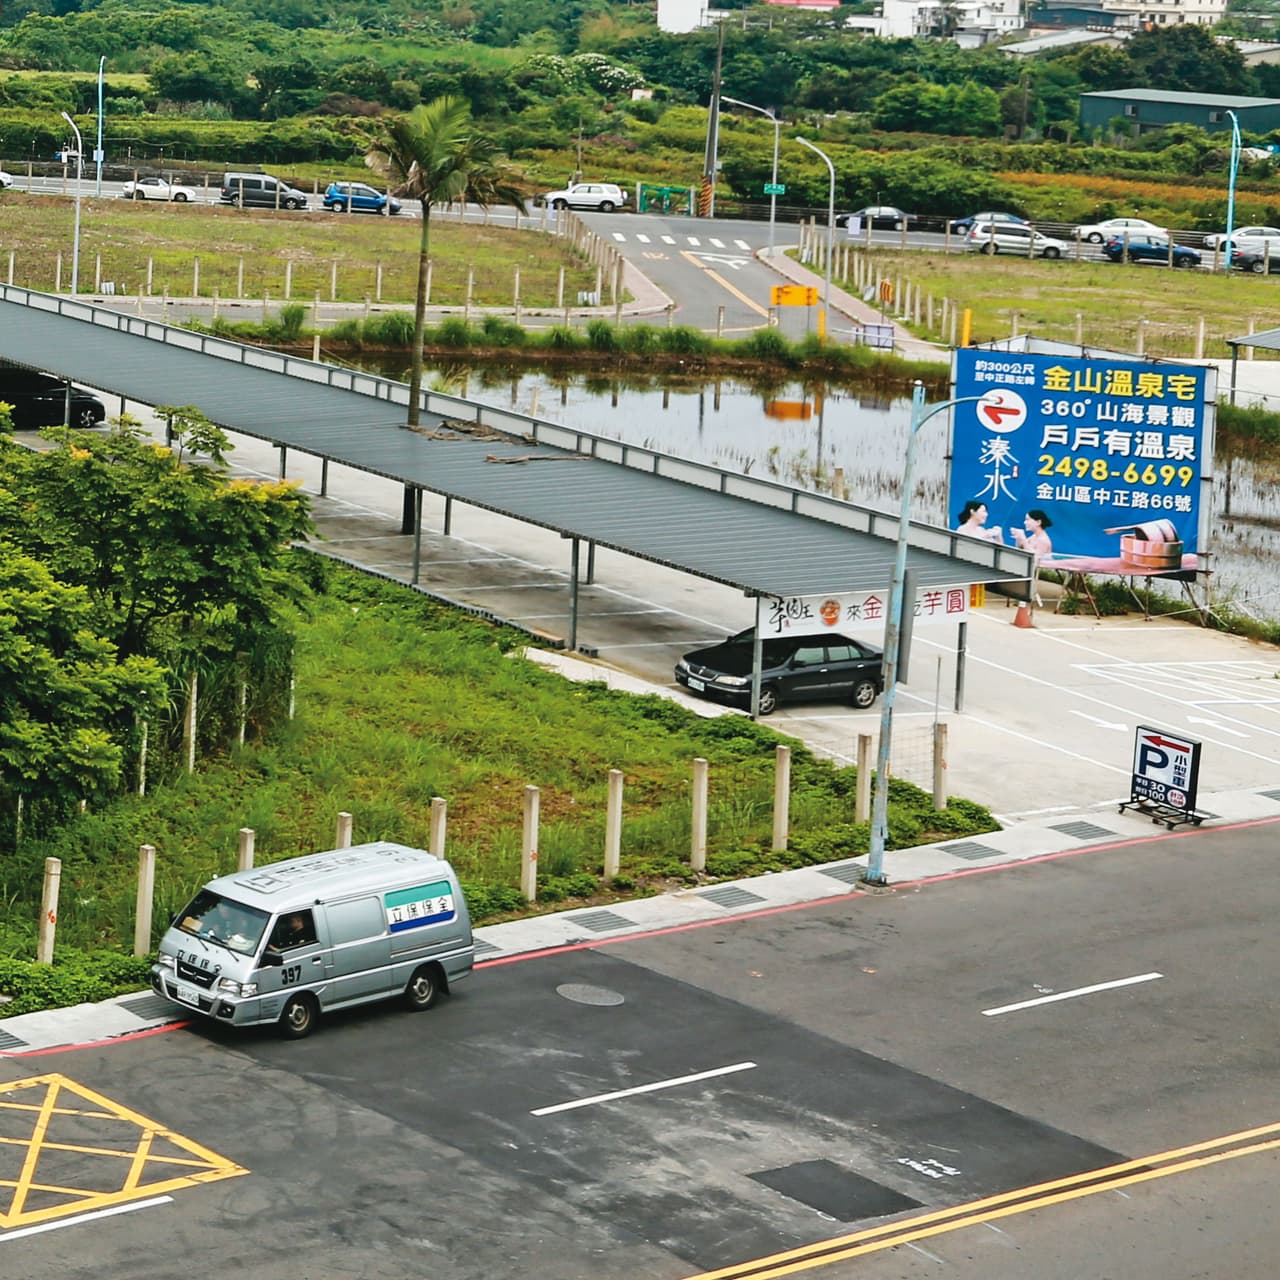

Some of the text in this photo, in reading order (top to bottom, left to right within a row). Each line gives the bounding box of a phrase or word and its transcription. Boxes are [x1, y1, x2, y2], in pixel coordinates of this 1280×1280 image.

[975, 360, 1035, 375] 約300公尺
[1042, 365, 1197, 401] 金山溫泉宅
[1096, 401, 1195, 428] 山海景觀
[1037, 454, 1194, 488] 2498-6699
[1036, 482, 1193, 513] 金山區中正路66號
[1148, 789, 1165, 802] 100
[1150, 781, 1166, 793] 30
[281, 965, 302, 985] 397
